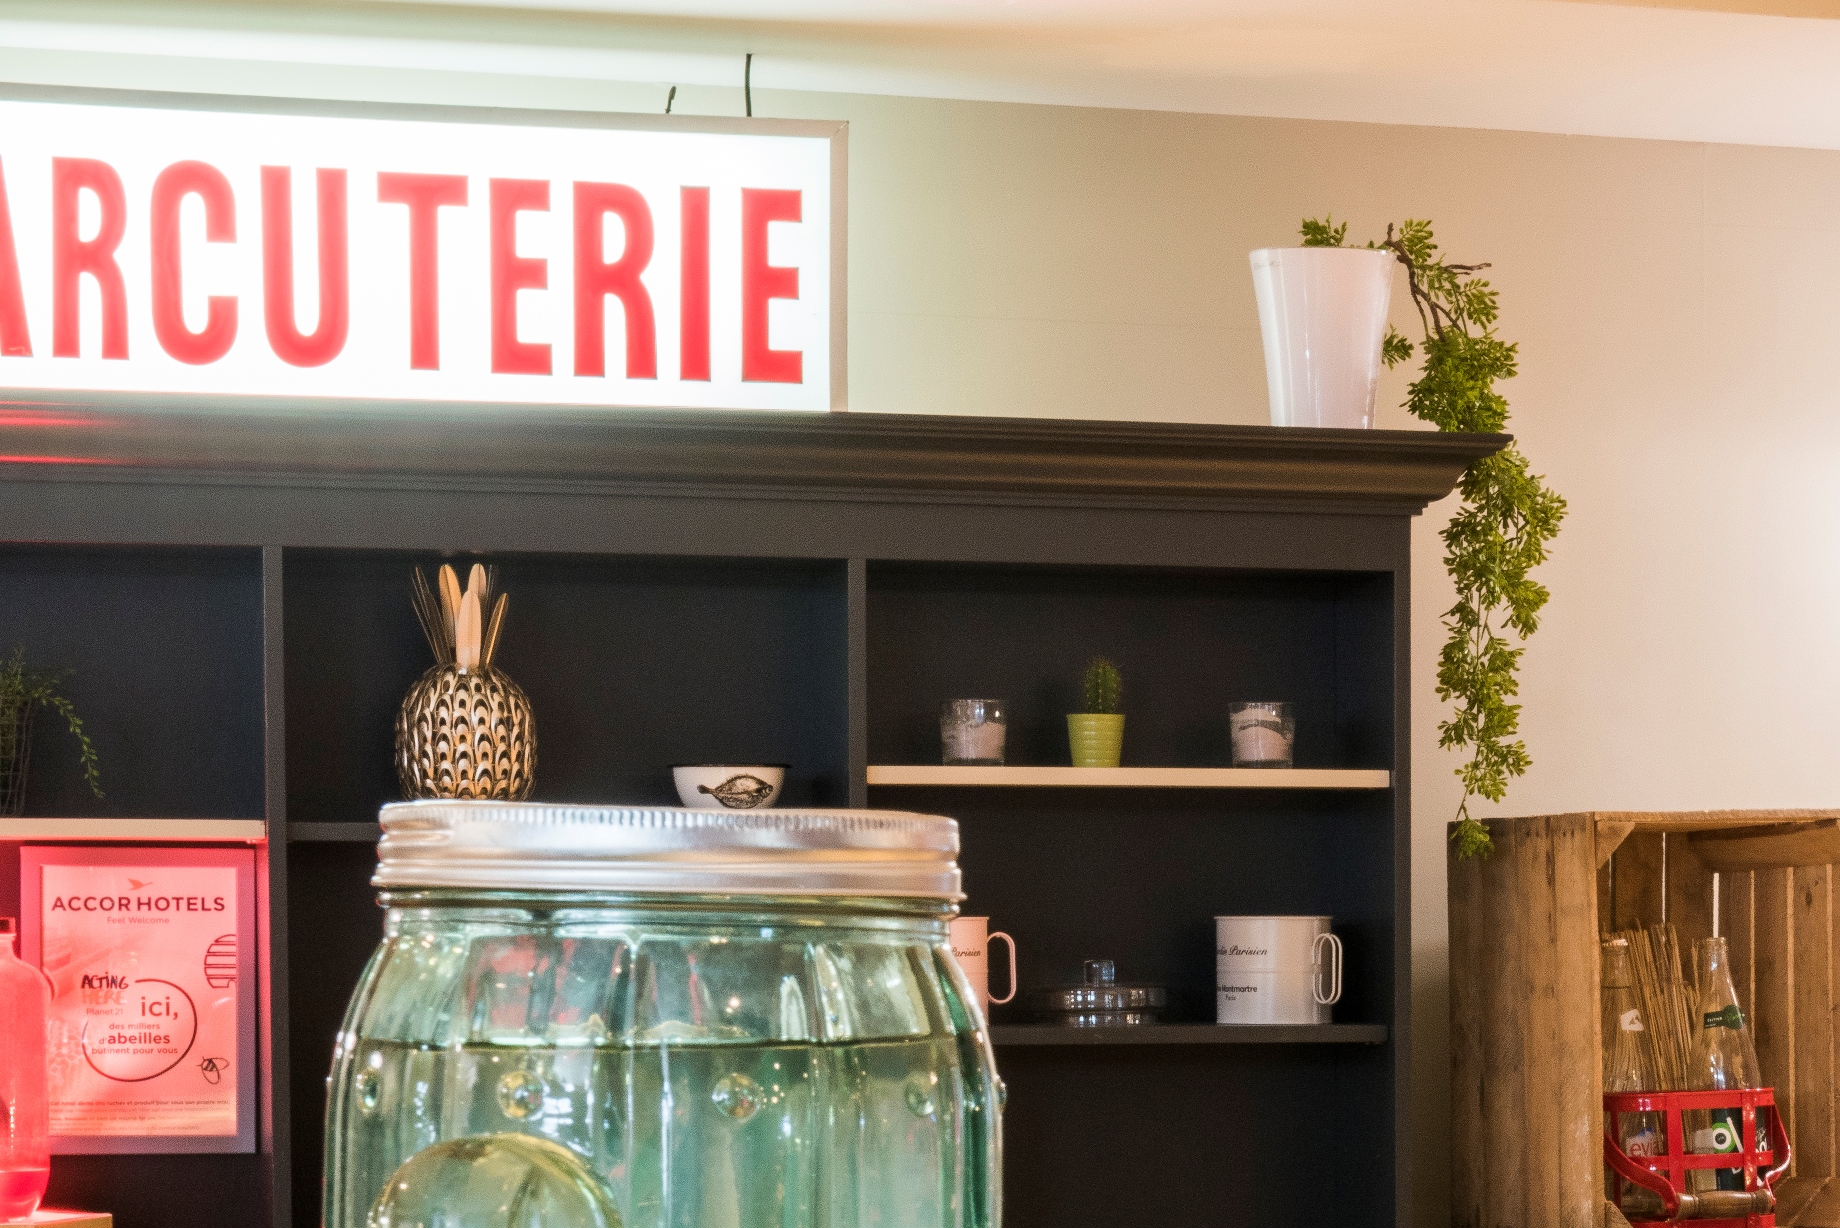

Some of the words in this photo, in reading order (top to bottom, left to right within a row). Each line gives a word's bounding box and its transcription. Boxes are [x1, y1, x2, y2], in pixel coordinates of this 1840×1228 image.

[107, 916, 126, 924] Feel
[128, 916, 170, 924] Welcome
[1229, 945, 1267, 955] Parisien
[81, 971, 129, 989] ACTING
[86, 1008, 113, 1016] Planet
[141, 996, 178, 1020] ici,
[99, 1032, 170, 1045] d'abeilles
[92, 1047, 130, 1055] butinent
[132, 1048, 154, 1056] pour
